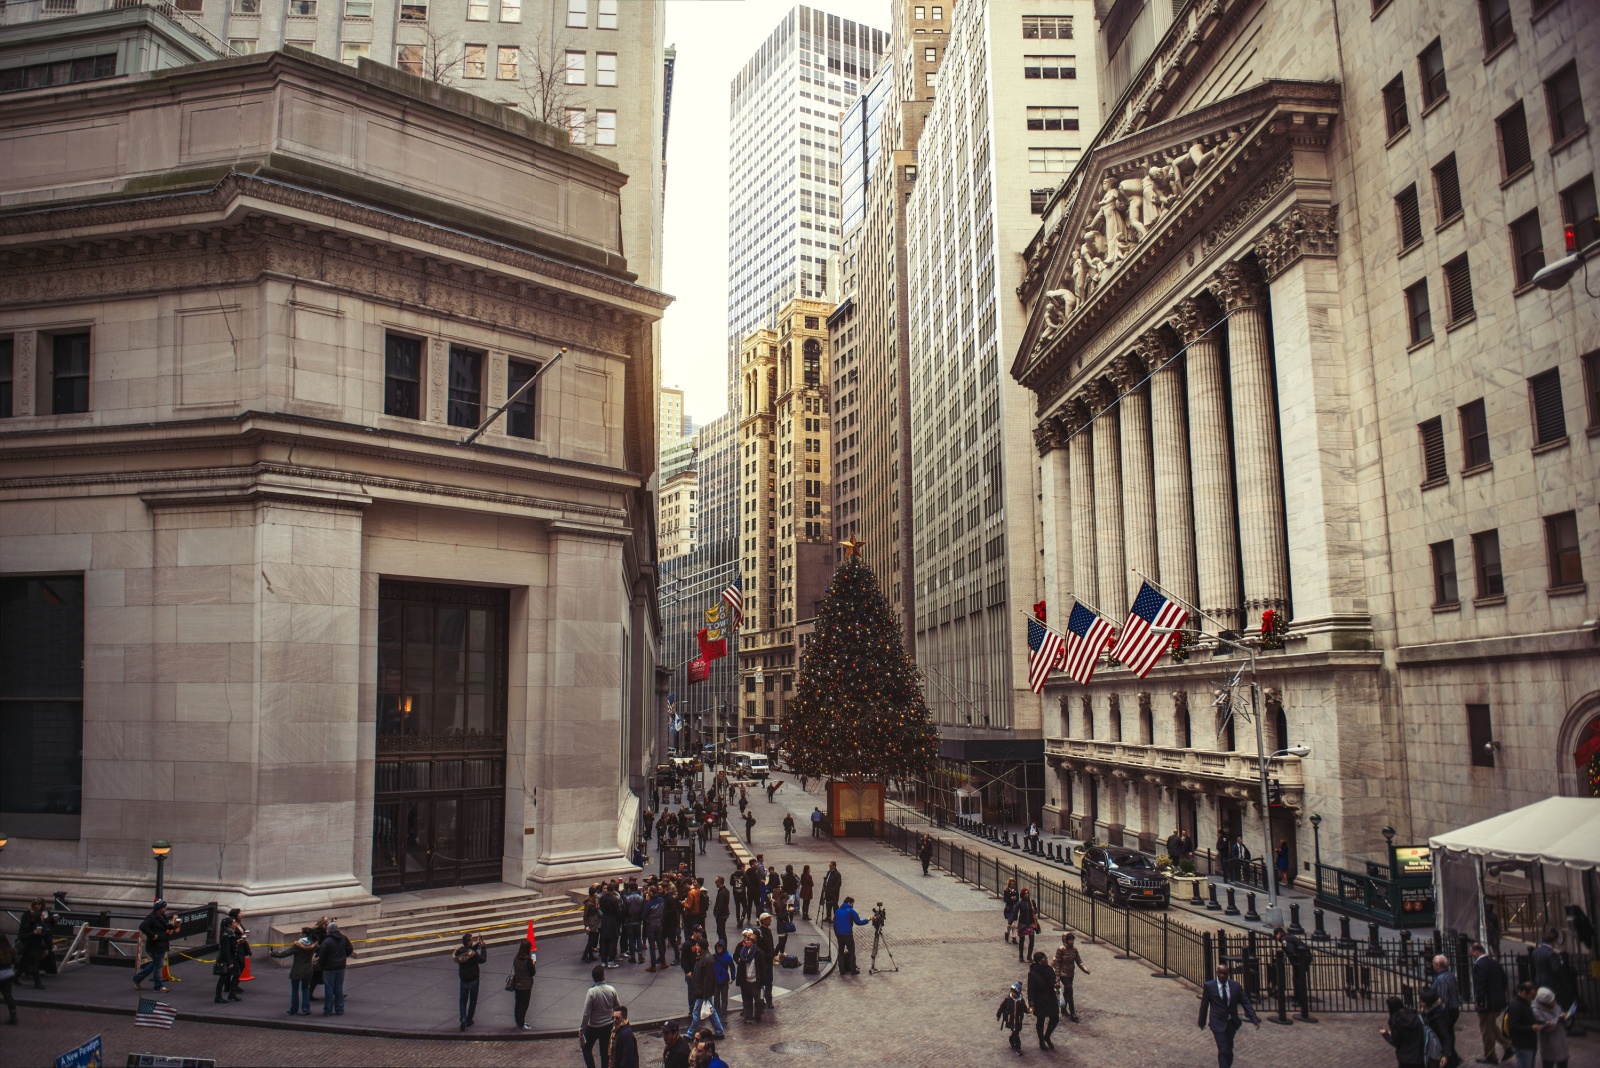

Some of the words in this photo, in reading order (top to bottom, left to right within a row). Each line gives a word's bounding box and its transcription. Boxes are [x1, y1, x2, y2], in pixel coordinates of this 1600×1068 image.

[1085, 343, 1098, 361] NEW
[1100, 326, 1116, 348] YORK
[1119, 305, 1140, 331] STOCK
[1142, 263, 1182, 309] EXCHANGE
[57, 917, 85, 927] ubway
[191, 912, 208, 922] Station
[66, 1052, 78, 1063] New
